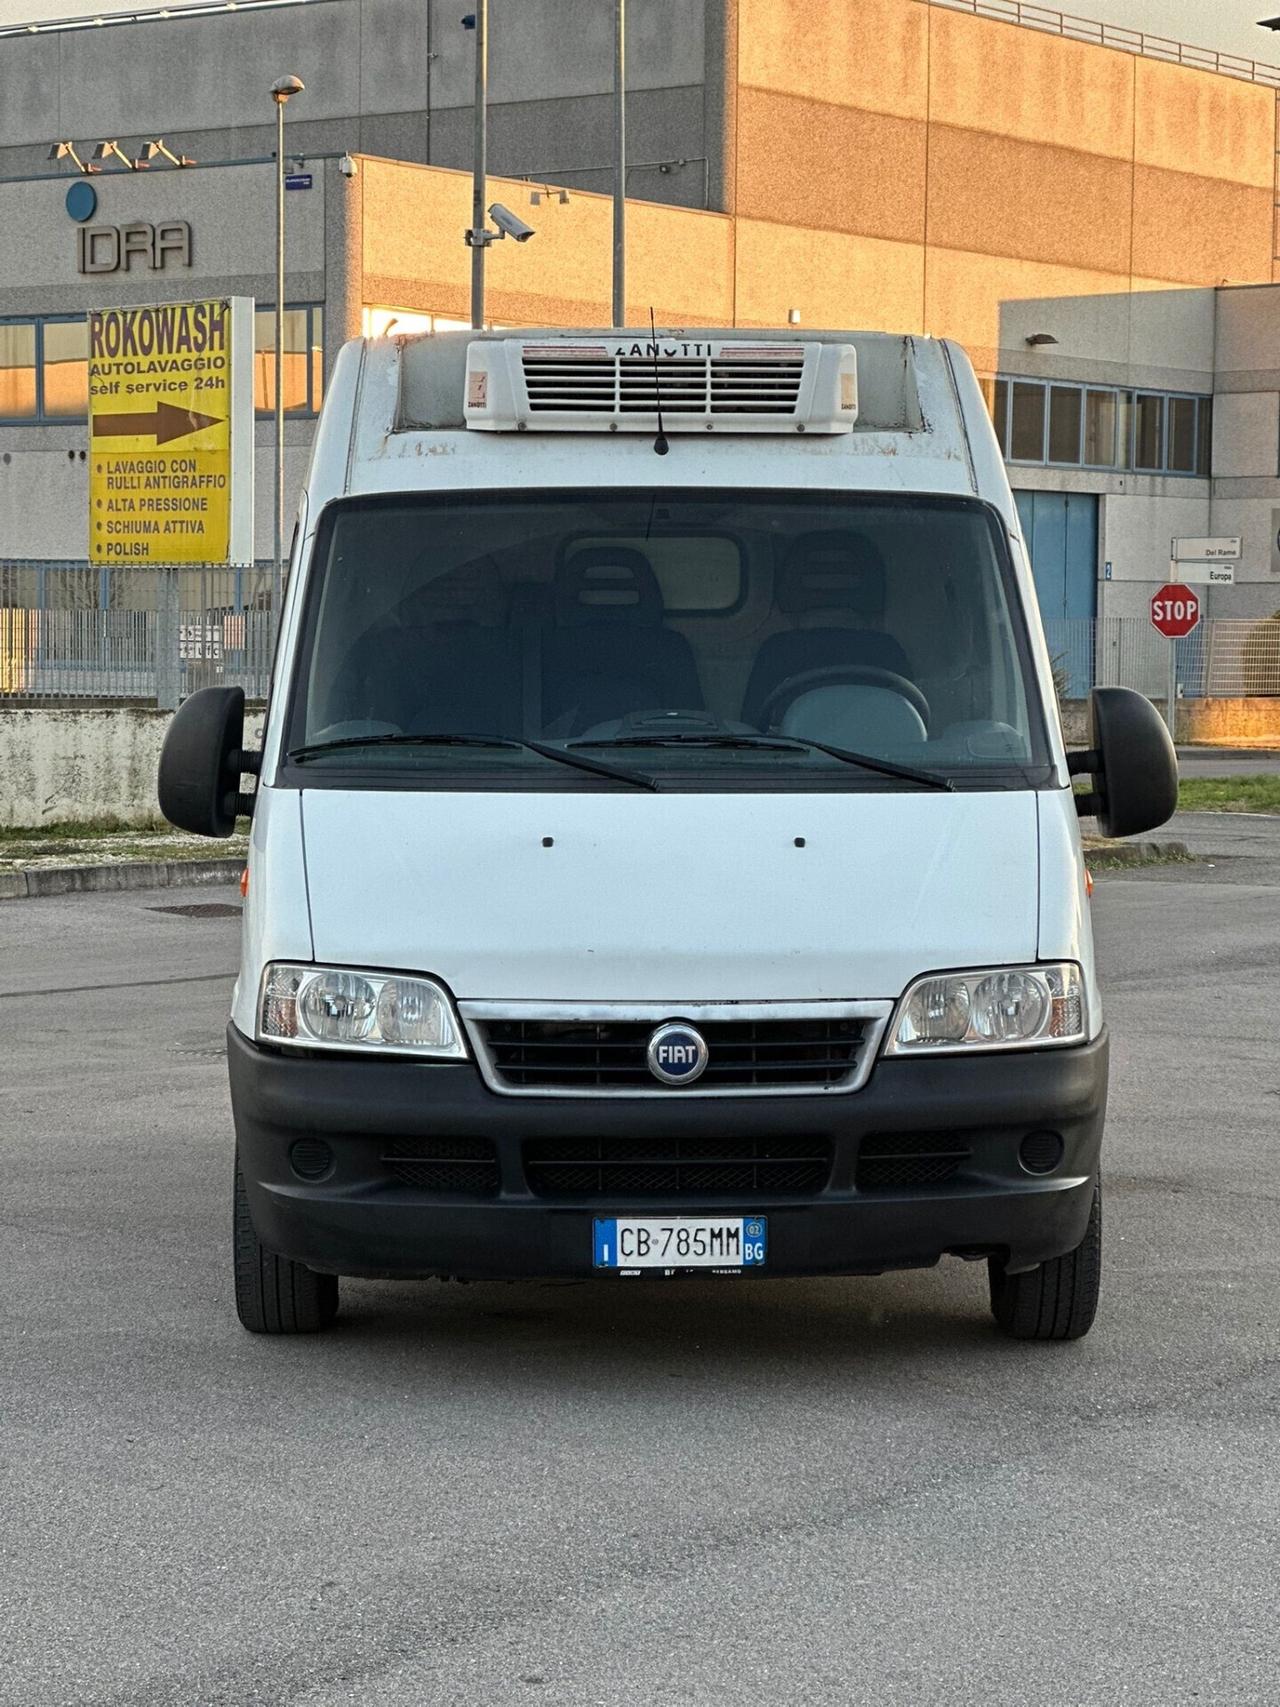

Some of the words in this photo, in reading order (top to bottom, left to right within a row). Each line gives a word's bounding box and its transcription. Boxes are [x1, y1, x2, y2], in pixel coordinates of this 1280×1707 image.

[90, 303, 226, 359] ROKOWASH
[90, 356, 226, 377] AUTOLAVAGGIO
[90, 381, 121, 396] self
[125, 379, 189, 395] service
[194, 376, 226, 391] 24h
[106, 460, 167, 475] LAVAGGIO
[171, 459, 197, 473] CON
[106, 476, 141, 490] RULLI
[144, 474, 226, 489] ANTIGRAFFIO
[106, 498, 136, 512] ALTA
[139, 497, 208, 512] PRESSIONE
[106, 520, 160, 534] SCHIUMA
[163, 520, 205, 534] ATTIVA
[106, 542, 149, 556] POLISH
[1210, 571, 1232, 581] Europa
[1153, 600, 1197, 621] STOP
[658, 1045, 696, 1064] FIAT
[744, 1243, 764, 1261] BG
